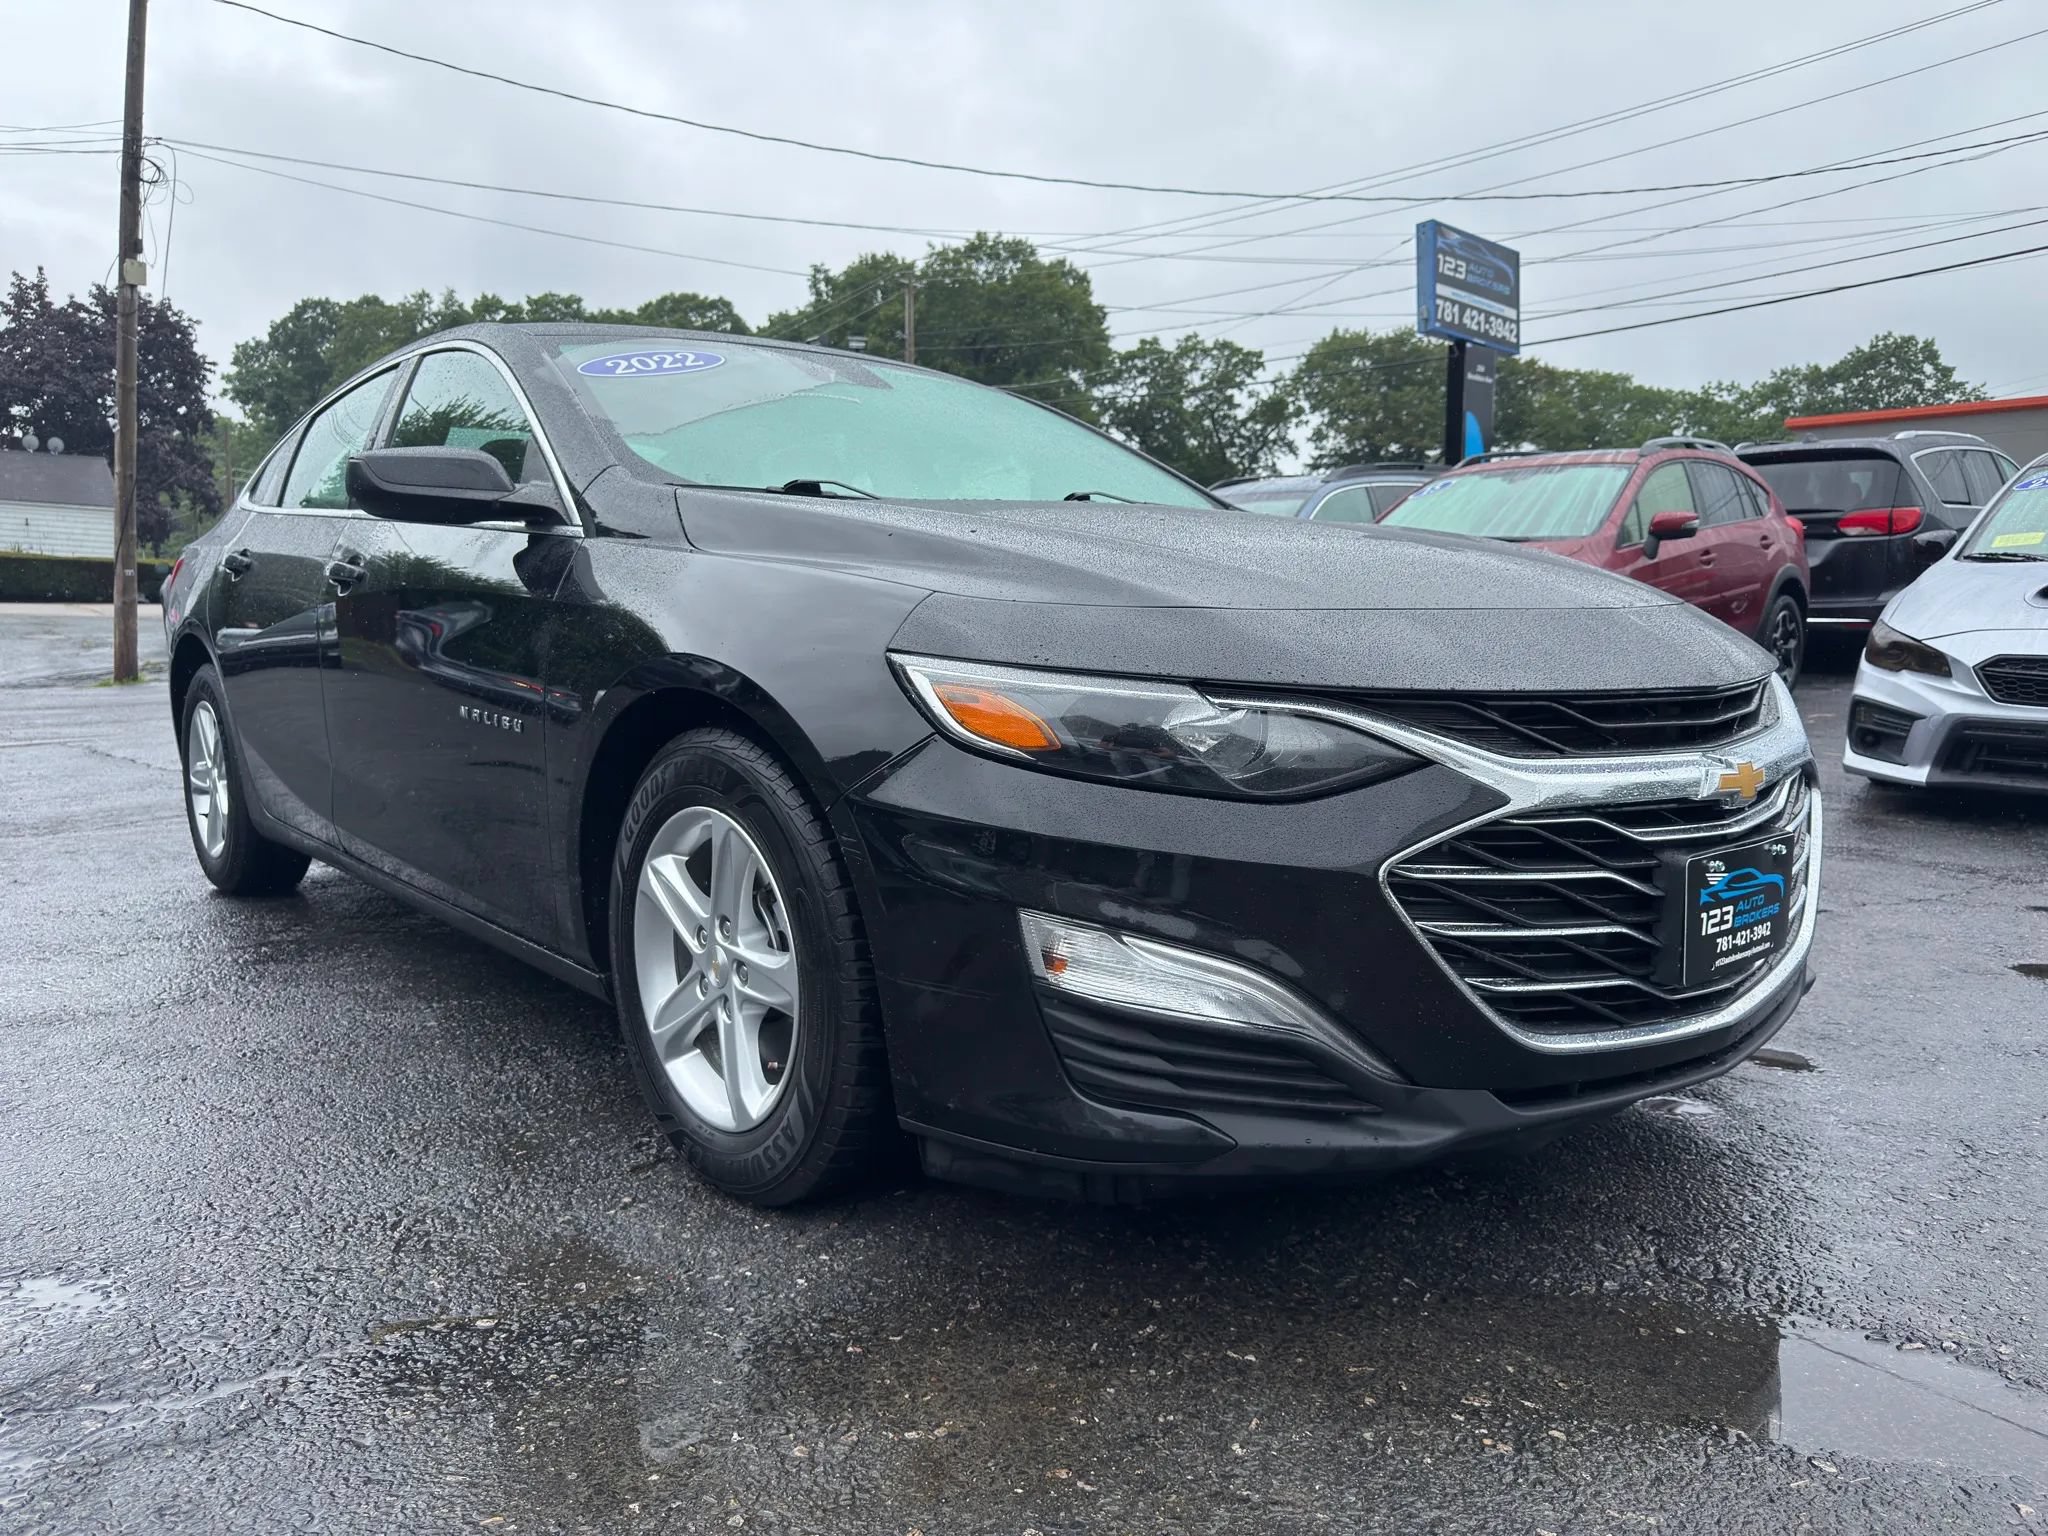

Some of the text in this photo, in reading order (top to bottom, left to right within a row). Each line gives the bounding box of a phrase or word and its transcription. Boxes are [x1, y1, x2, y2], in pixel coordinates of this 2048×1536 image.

[1437, 253, 1467, 280] 123
[1467, 262, 1495, 279] AUTO
[1435, 298, 1460, 325] 781
[1462, 307, 1517, 343] 421-3942
[605, 352, 705, 375] 2022
[460, 705, 523, 732] MALIBU
[1734, 902, 1780, 928] BROKERS
[1736, 894, 1764, 912] AUTO
[1700, 905, 1734, 936] 123
[1716, 921, 1771, 953] 781-421-3942
